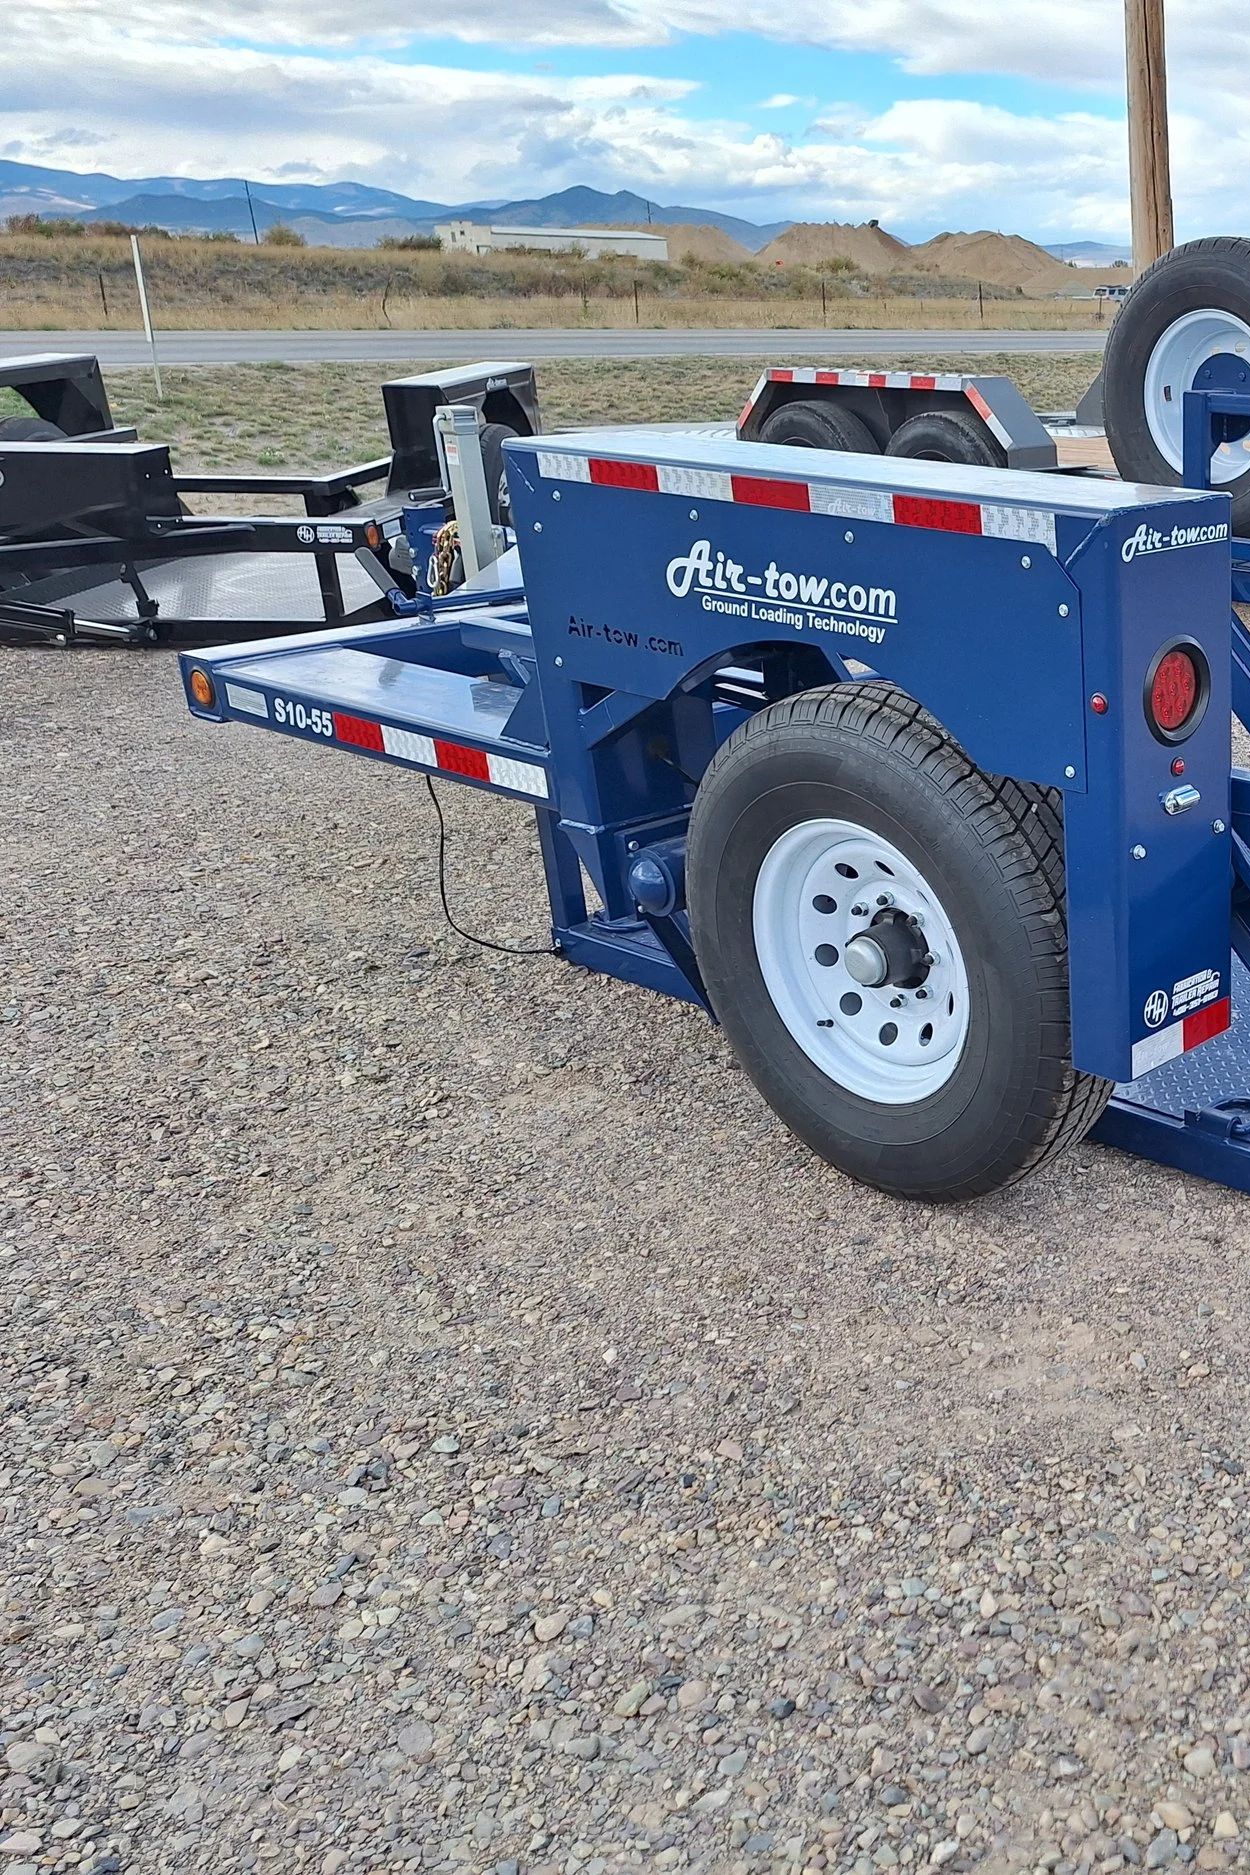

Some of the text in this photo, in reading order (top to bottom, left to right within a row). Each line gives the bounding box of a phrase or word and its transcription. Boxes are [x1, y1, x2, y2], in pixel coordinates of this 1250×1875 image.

[1121, 522, 1228, 563] Air-tow.com
[665, 539, 898, 617] Air-tow.com
[701, 595, 886, 644] Ground Loading Technology
[274, 697, 333, 737] S10-55
[1171, 988, 1197, 1010] TRAILER
